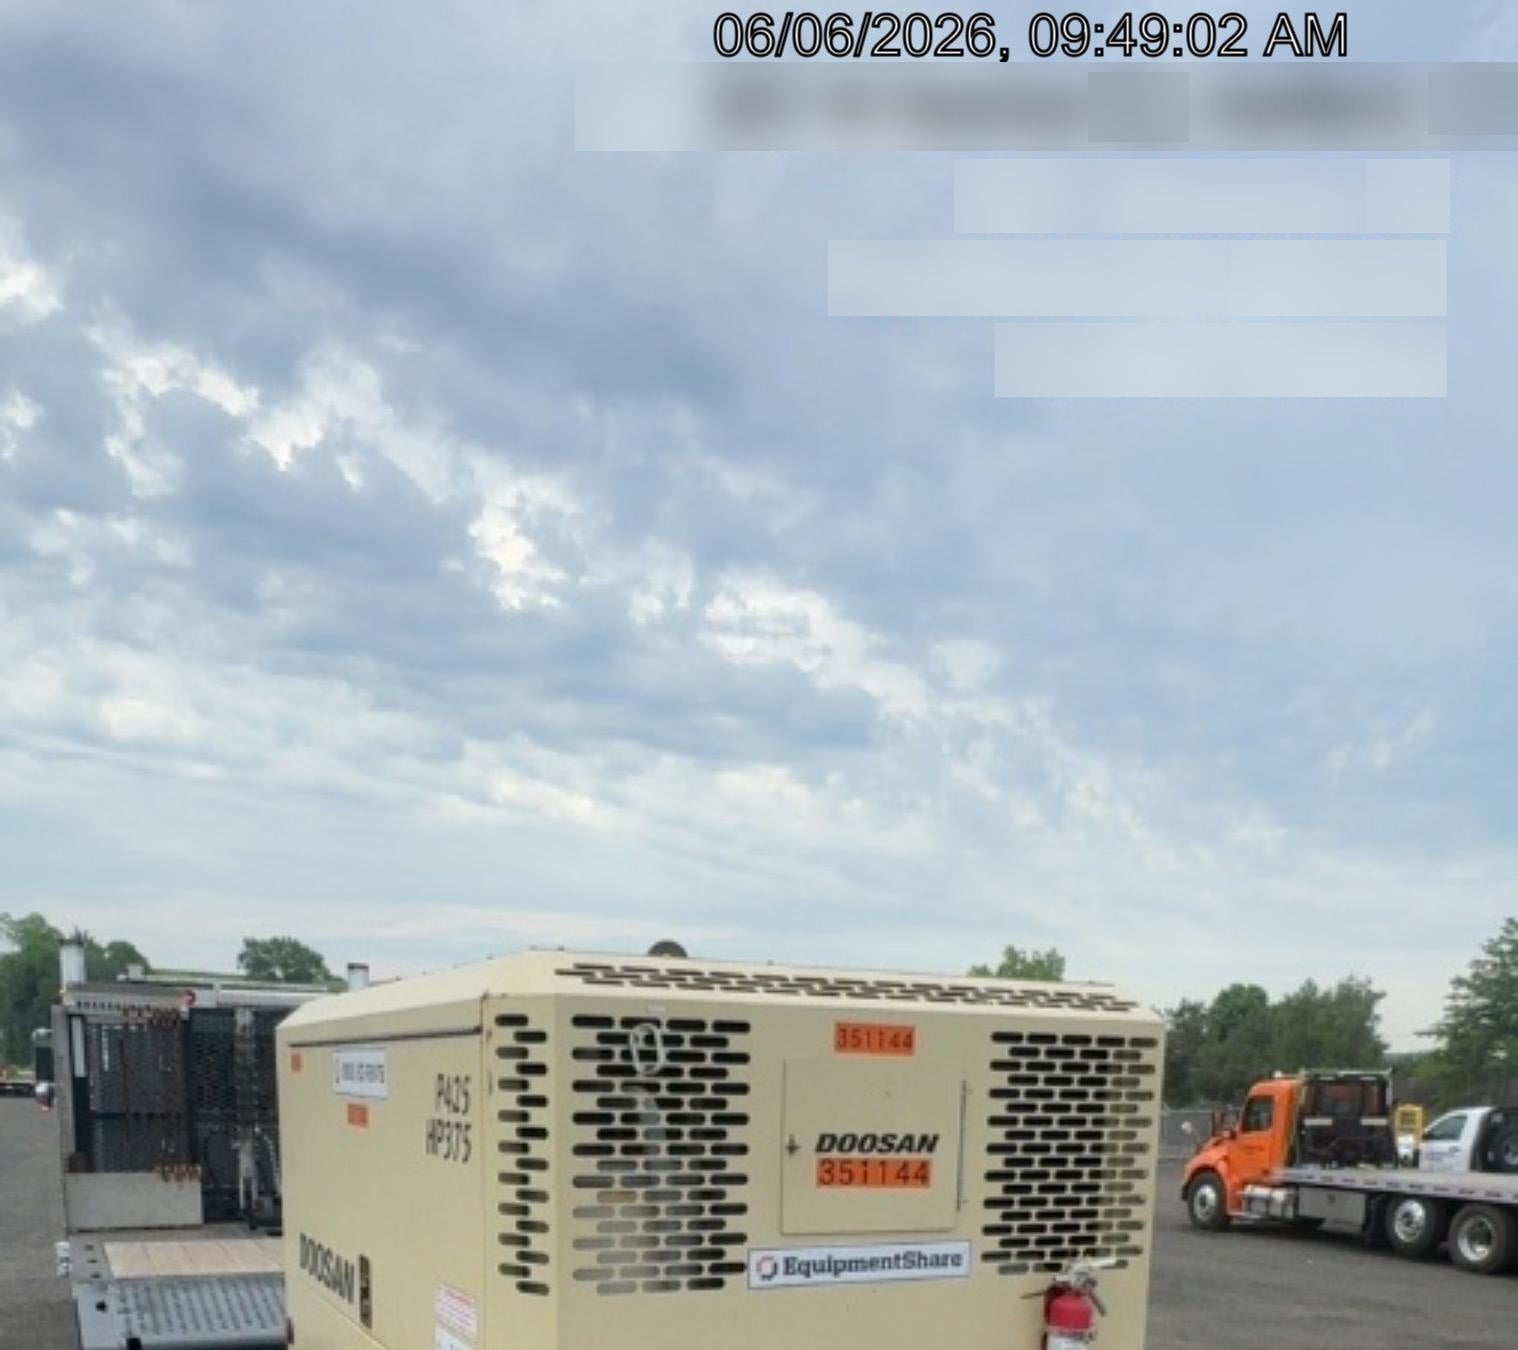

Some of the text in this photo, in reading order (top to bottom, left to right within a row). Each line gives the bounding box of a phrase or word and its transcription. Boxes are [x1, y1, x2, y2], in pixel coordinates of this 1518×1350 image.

[836, 1027, 914, 1050] 351144
[434, 1073, 472, 1116] P425
[425, 1118, 472, 1164] HP375
[815, 1133, 940, 1154] DOOSAN
[818, 1158, 930, 1185] 351144
[299, 1231, 355, 1305] DOOSAN
[782, 1249, 963, 1279] EquipmentShare
